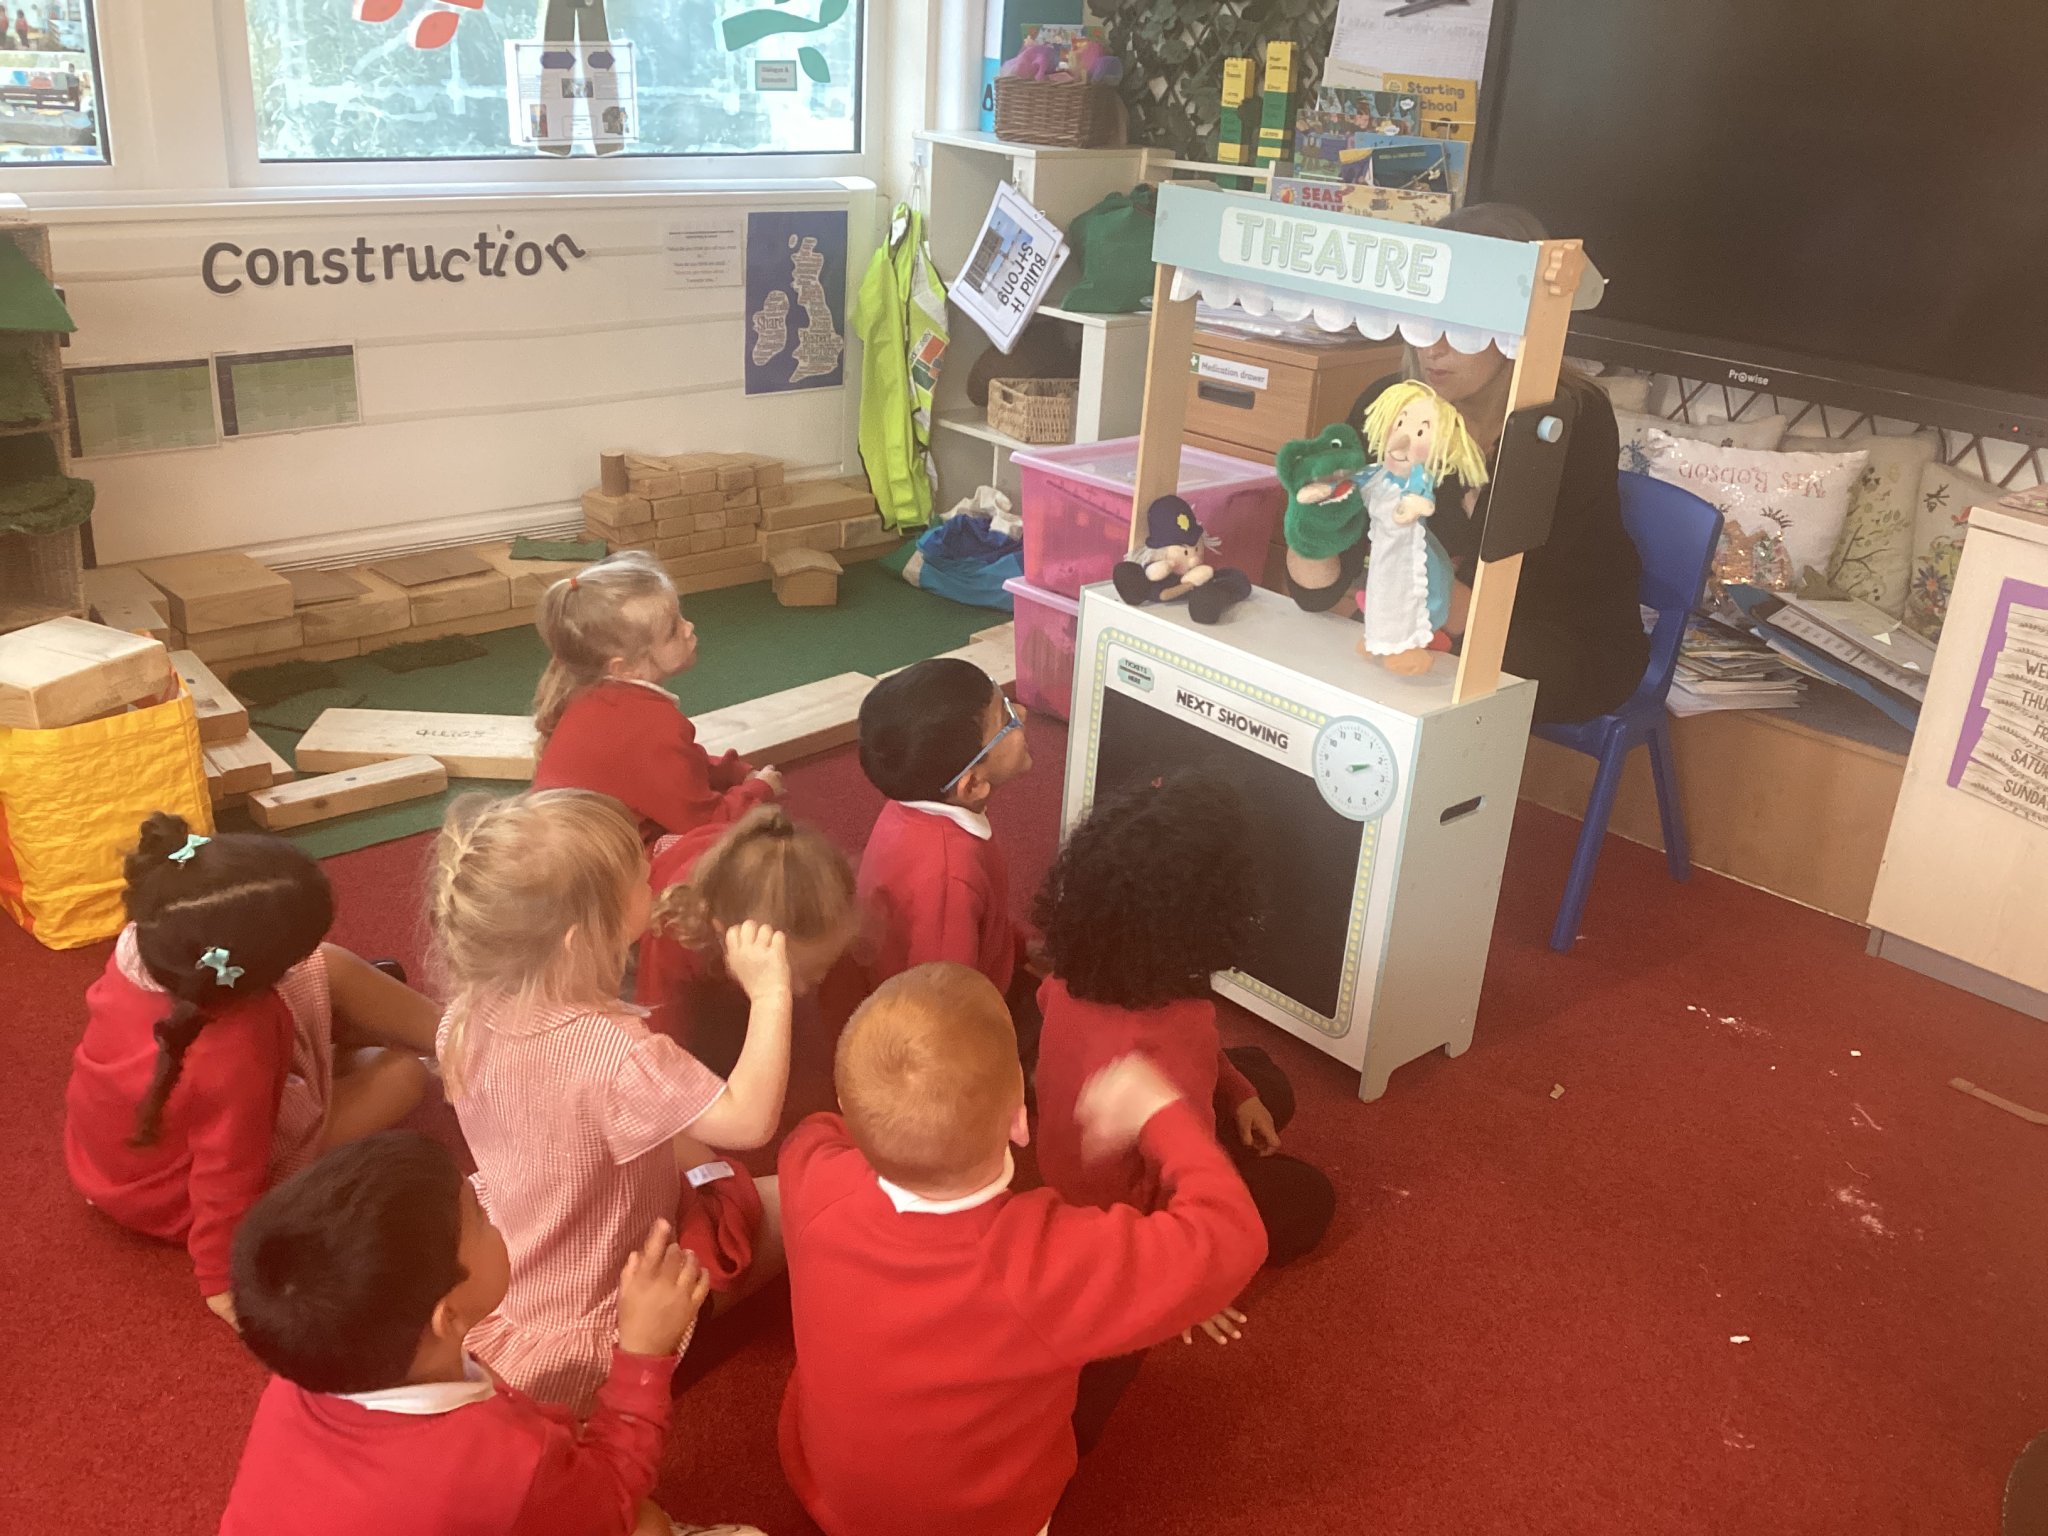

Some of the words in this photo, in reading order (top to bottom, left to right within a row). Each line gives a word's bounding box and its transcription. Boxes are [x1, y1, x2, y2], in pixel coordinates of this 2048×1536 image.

[1407, 81, 1466, 100] Starting
[1420, 100, 1457, 112] chool
[1302, 186, 1343, 203] SEAS
[202, 229, 586, 295] Construction
[1236, 211, 1438, 297] THEATRE
[1728, 368, 1769, 386] Prowise
[2026, 659, 2048, 680] WE
[2021, 690, 2048, 712] THU
[1176, 689, 1215, 717] NEXT
[1217, 708, 1289, 750] SHOWING
[2033, 724, 2048, 743] FR
